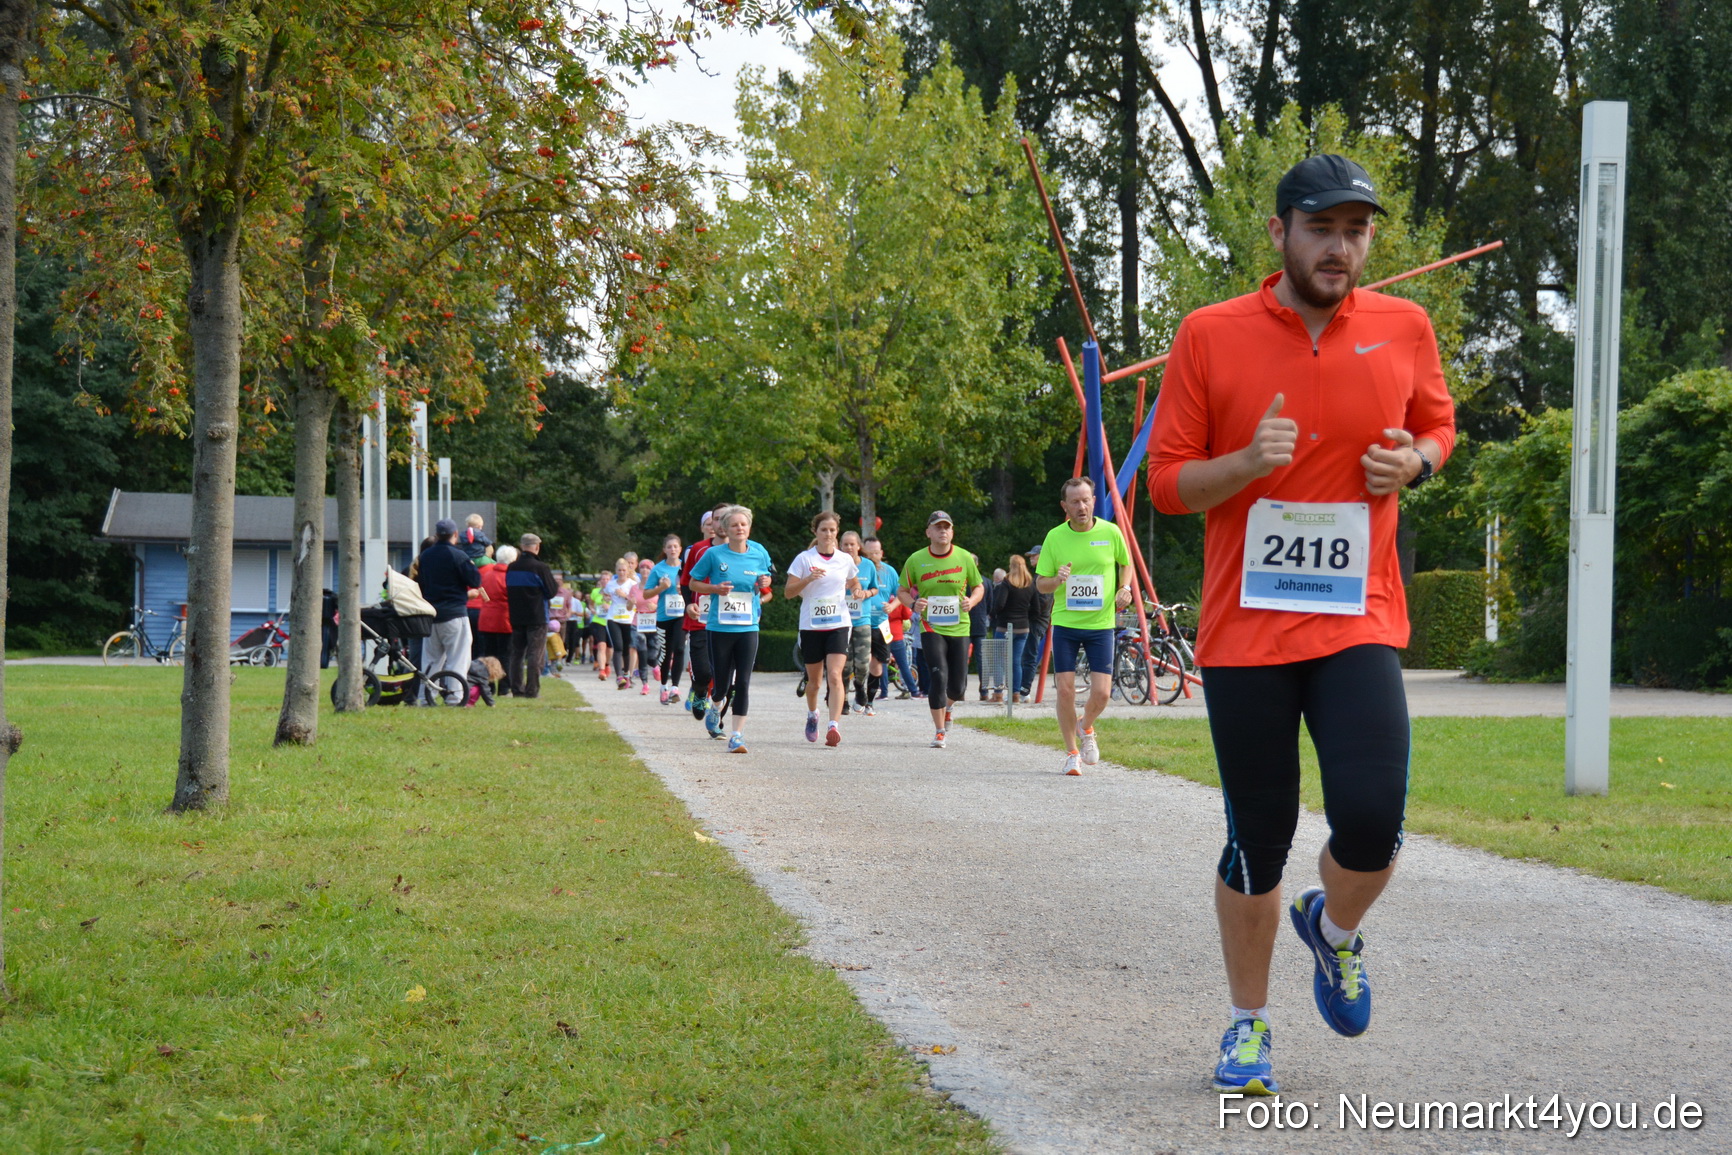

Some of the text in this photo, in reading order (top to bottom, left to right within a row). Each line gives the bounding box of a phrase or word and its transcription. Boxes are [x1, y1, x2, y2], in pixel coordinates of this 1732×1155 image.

[1353, 179, 1373, 191] 2XU
[1295, 512, 1336, 523] BOCK
[1262, 534, 1350, 570] 2418
[1274, 578, 1333, 593] Johannes
[1071, 586, 1098, 597] 2304
[724, 601, 746, 612] 2471
[814, 605, 837, 616] 2607
[932, 605, 955, 614] 2765
